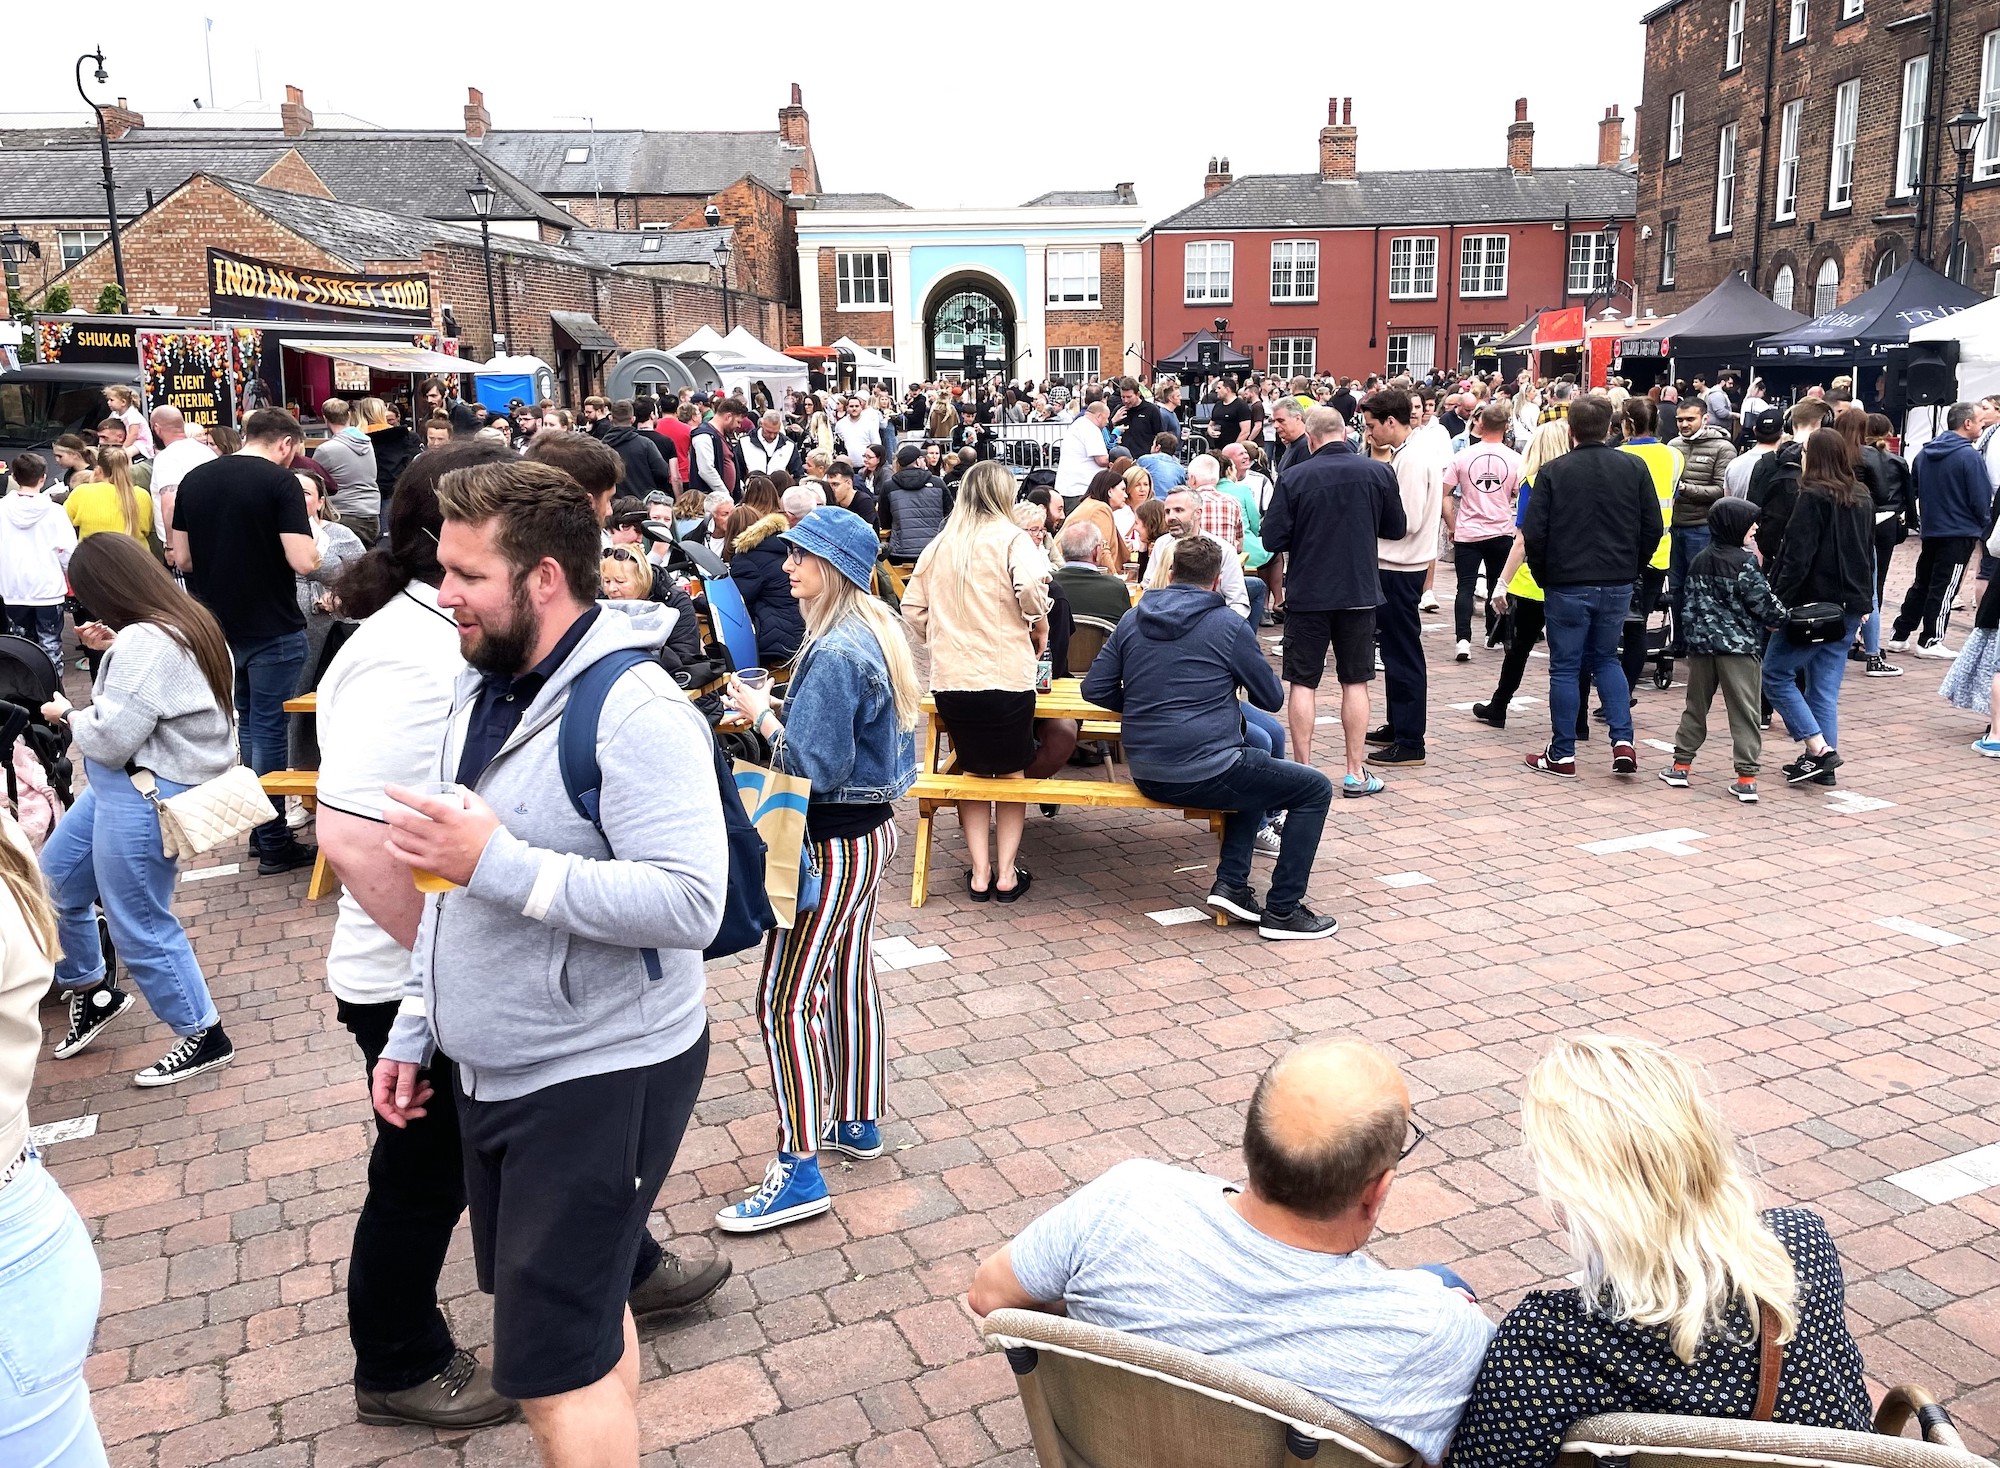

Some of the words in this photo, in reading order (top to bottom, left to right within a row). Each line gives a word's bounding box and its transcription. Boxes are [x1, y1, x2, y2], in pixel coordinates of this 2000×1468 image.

[213, 258, 299, 301] INDIAN
[300, 275, 379, 308] STREET
[381, 280, 429, 310] FOOD
[77, 331, 131, 348] SHUKAR
[173, 375, 205, 390] EVENT
[167, 393, 214, 409] CATERING
[184, 410, 219, 425] ILABLE
